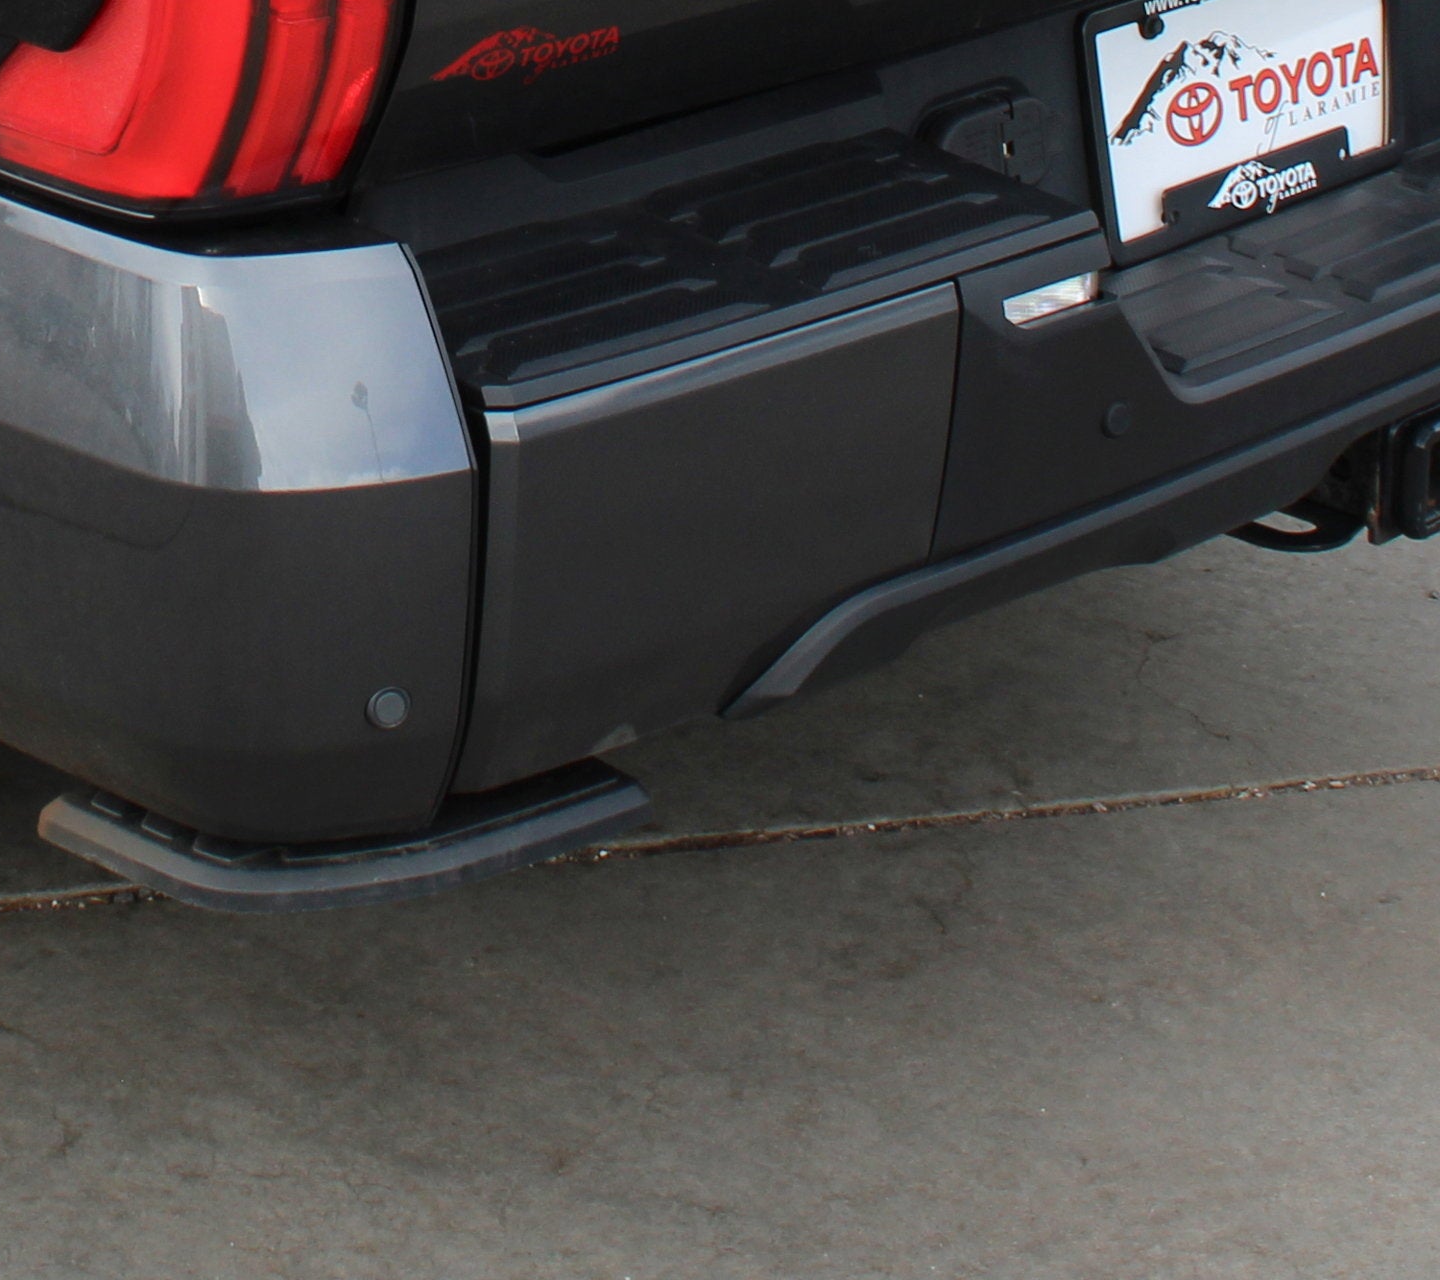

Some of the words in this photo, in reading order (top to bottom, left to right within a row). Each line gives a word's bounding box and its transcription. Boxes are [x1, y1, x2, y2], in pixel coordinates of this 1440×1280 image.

[520, 25, 620, 67] TOYOTA
[1228, 37, 1380, 122] TOYOTA
[1288, 80, 1381, 128] LARAMIE
[1256, 161, 1317, 198] TOYOTA
[1278, 179, 1318, 200] LARAMIE
